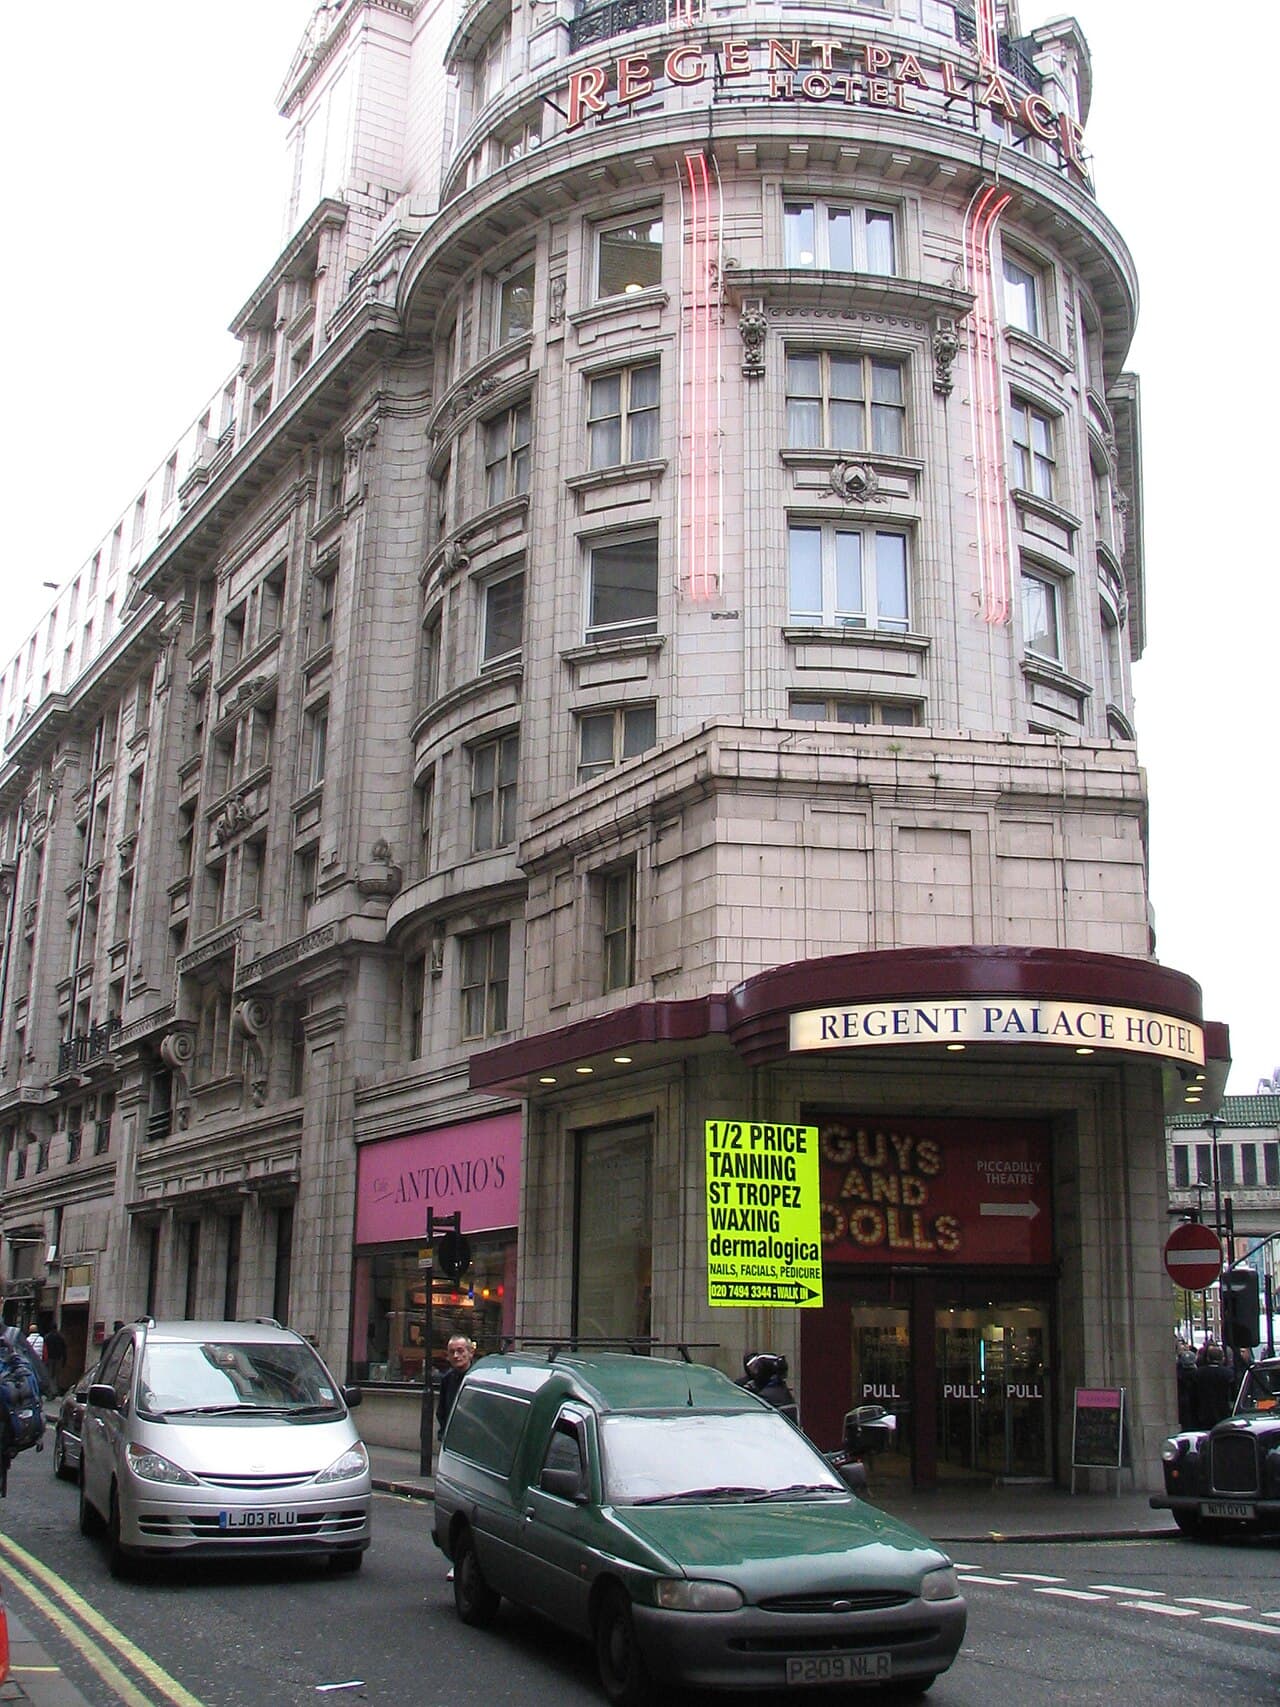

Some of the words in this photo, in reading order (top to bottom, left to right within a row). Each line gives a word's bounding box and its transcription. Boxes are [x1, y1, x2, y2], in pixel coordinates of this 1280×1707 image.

[768, 72, 918, 114] HOTEL
[566, 38, 843, 134] REGENT
[863, 43, 1092, 180] PALACE
[819, 1007, 967, 1041] REGENT
[982, 1007, 1115, 1041] PALACE
[1125, 1016, 1196, 1056] HOTEL
[709, 1122, 743, 1150] 1/2
[750, 1124, 808, 1154] PRICE
[821, 1122, 941, 1176] GUYS
[394, 1155, 506, 1204] ANTONIO'S
[709, 1151, 797, 1182] TANNING
[976, 1160, 1043, 1173] PICCADILLY
[985, 1173, 1035, 1185] THEATRE
[709, 1181, 732, 1206] ST
[736, 1182, 802, 1209] TROPEZ
[840, 1167, 928, 1206] AND
[710, 1207, 780, 1233] WAXING
[820, 1200, 961, 1252] DOLLS
[710, 1233, 819, 1265] dermalogica
[709, 1262, 739, 1278] NAILS,
[740, 1264, 778, 1280] FACIALS,
[780, 1266, 821, 1280] PEDICURE
[711, 1283, 727, 1298] 020
[729, 1284, 749, 1299] 7494
[750, 1285, 771, 1299] 3344
[777, 1286, 799, 1300] WALK
[863, 1384, 900, 1398] PULL
[943, 1384, 979, 1399] PULL
[1006, 1384, 1043, 1398] PULL
[228, 1511, 264, 1527] LJ03
[268, 1511, 295, 1526] RLU
[790, 1658, 845, 1682] P209
[850, 1654, 890, 1678] NLR
